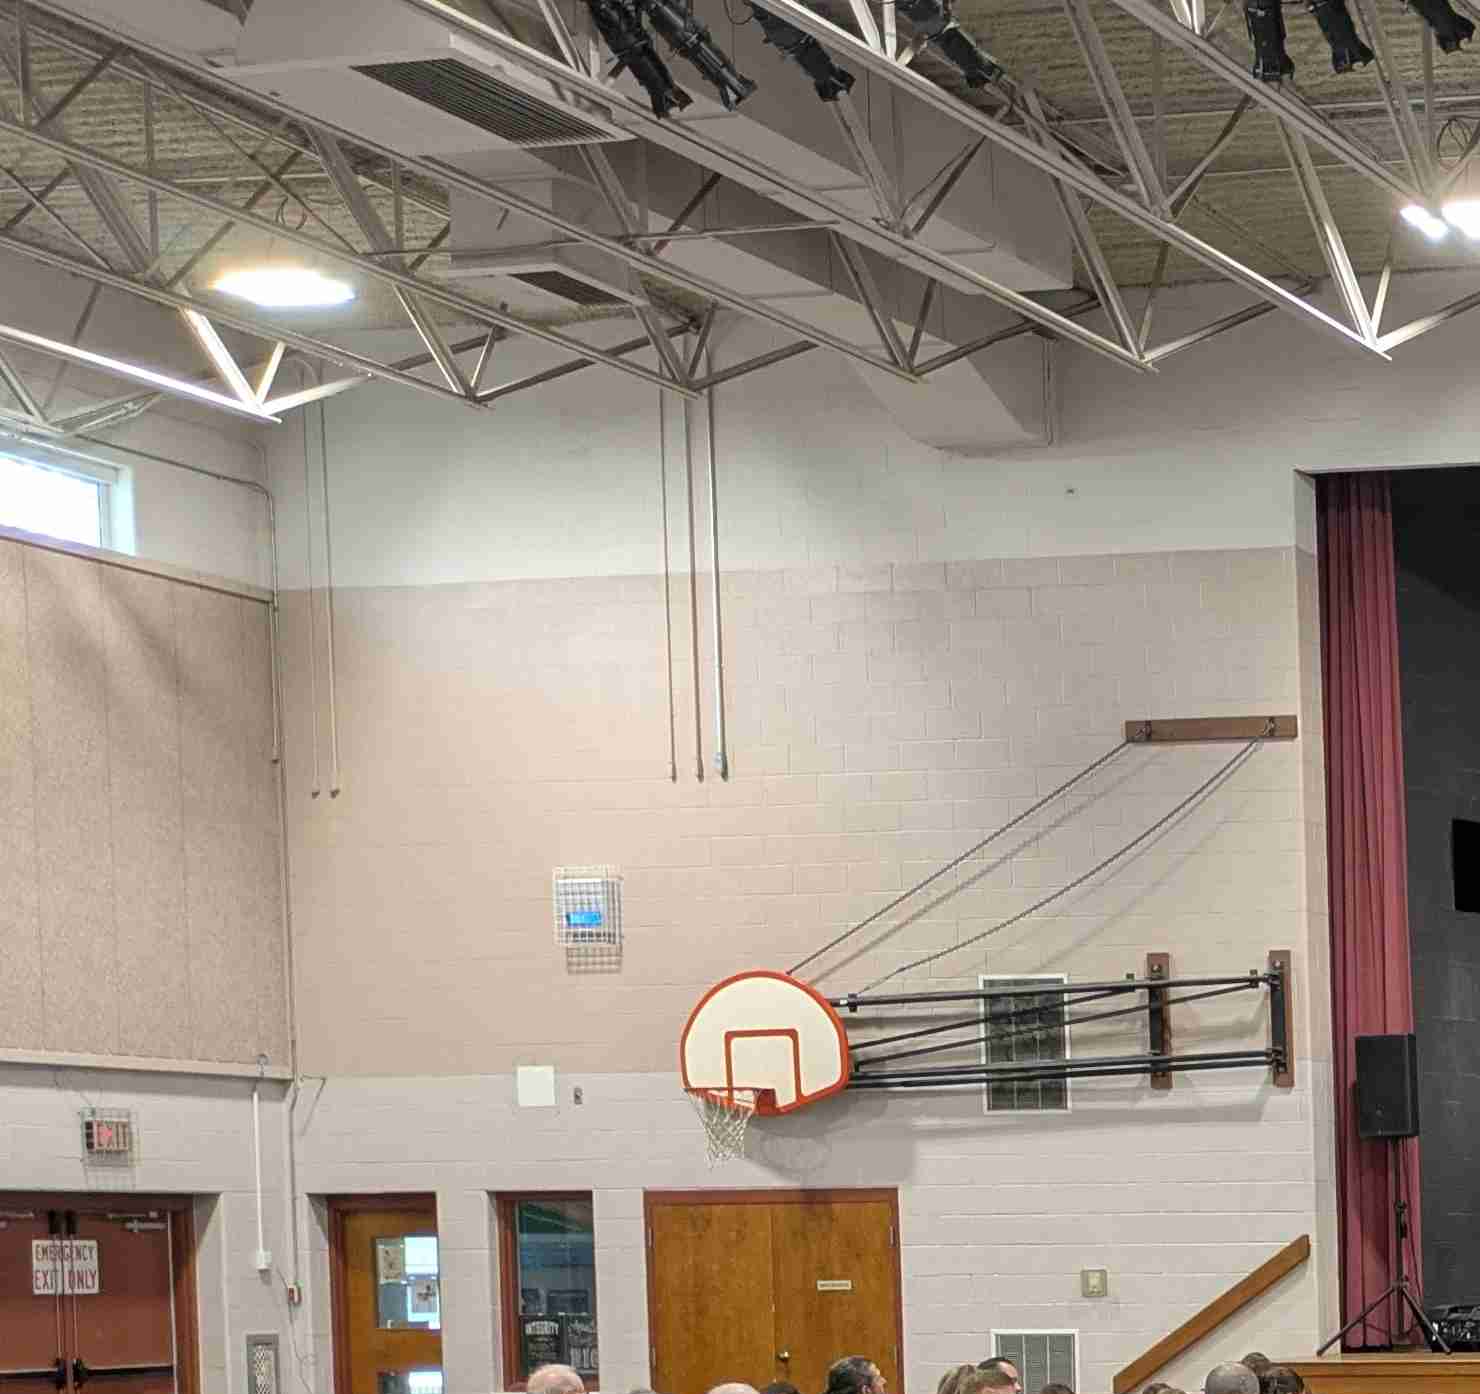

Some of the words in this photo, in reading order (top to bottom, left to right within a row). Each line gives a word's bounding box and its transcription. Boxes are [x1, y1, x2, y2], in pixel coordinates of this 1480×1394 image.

[96, 1121, 129, 1149] EXIT
[35, 1245, 96, 1261] EMERGENCY
[34, 1271, 61, 1290] EXIT
[67, 1270, 97, 1290] ONLY
